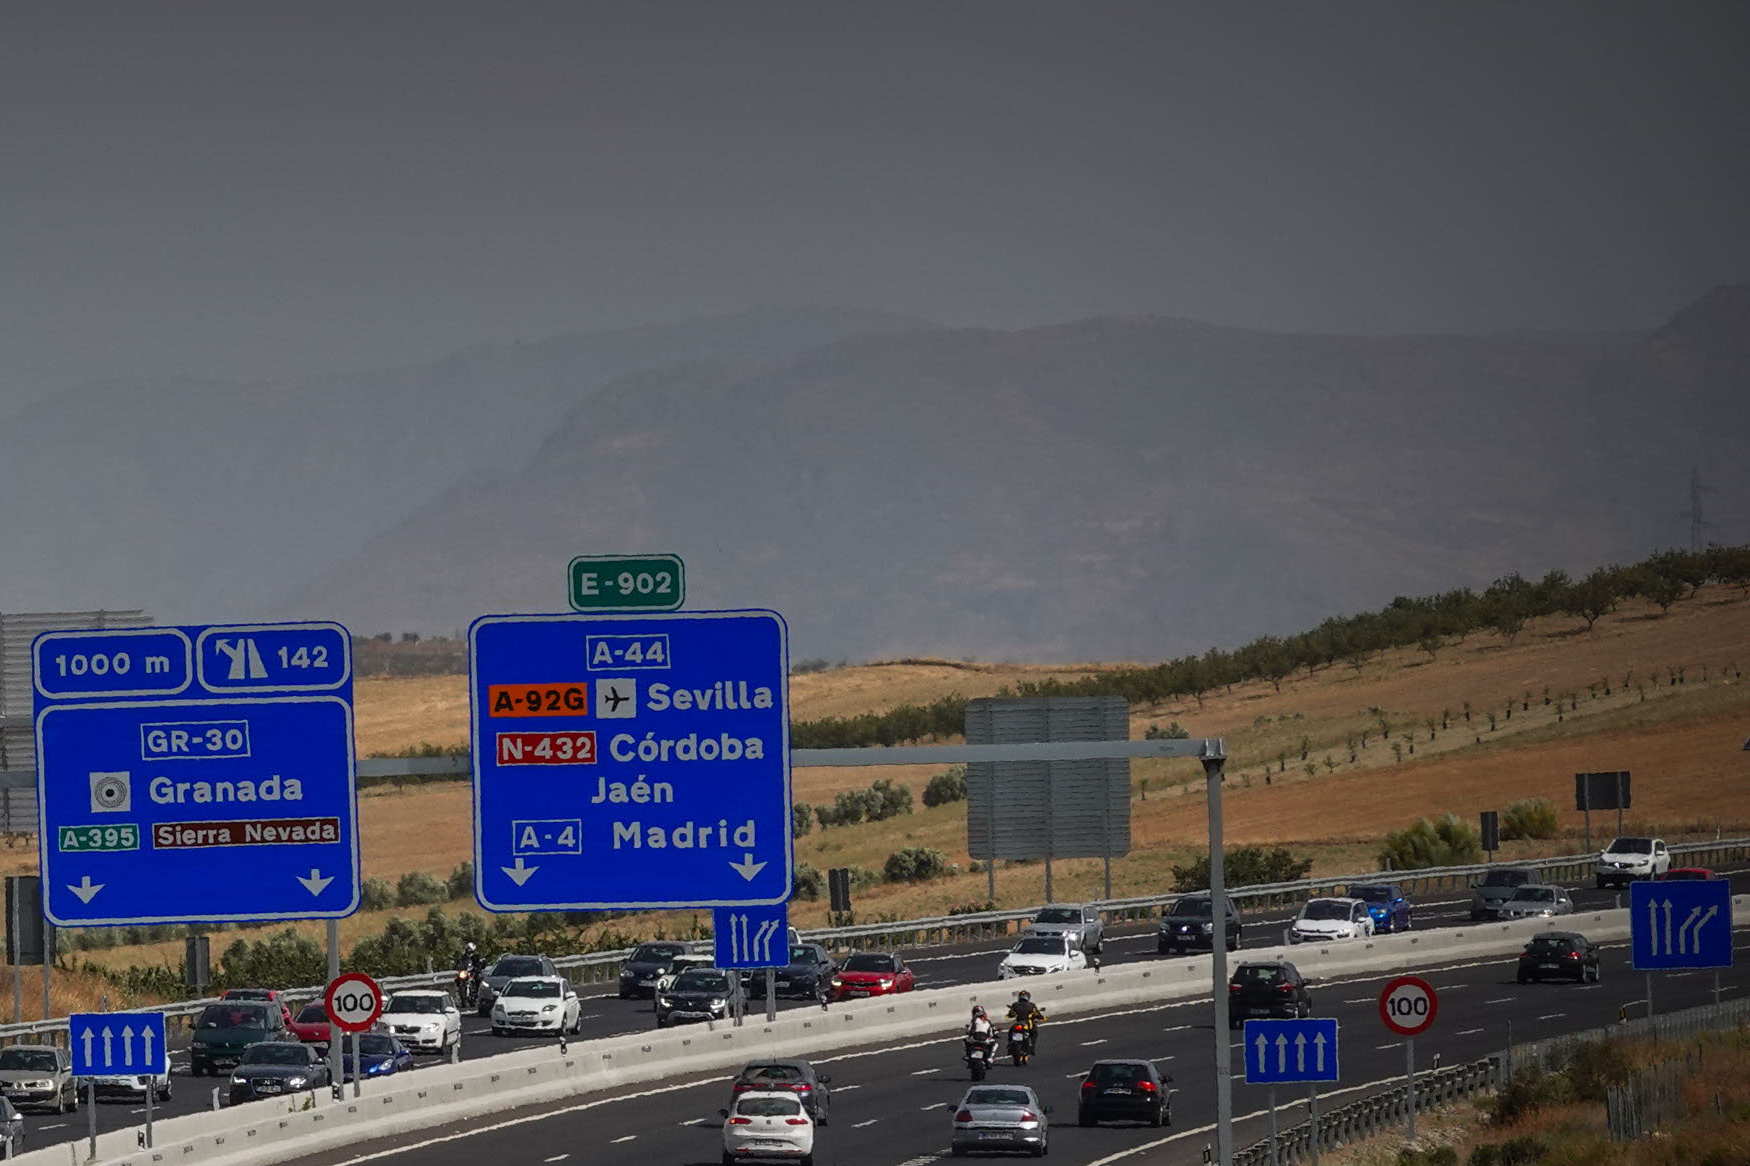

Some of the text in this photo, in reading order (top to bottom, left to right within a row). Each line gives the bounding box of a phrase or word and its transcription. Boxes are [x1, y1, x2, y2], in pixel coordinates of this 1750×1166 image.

[581, 571, 672, 596] E-902
[55, 652, 170, 677] 1000 m
[278, 645, 329, 669] 142
[592, 641, 665, 665] A-44
[494, 687, 585, 712] A-92G
[646, 680, 775, 711] Sevilla
[147, 728, 243, 753] GR-30
[502, 736, 592, 761] N-432
[609, 731, 764, 762] Córdoba
[150, 775, 304, 805] Granada
[591, 774, 674, 804] Jaén
[62, 826, 135, 849] A-395
[157, 821, 335, 846] Sierra Nevada
[612, 819, 756, 850] Madrid
[334, 992, 374, 1013] 100
[1388, 996, 1429, 1017] 100
